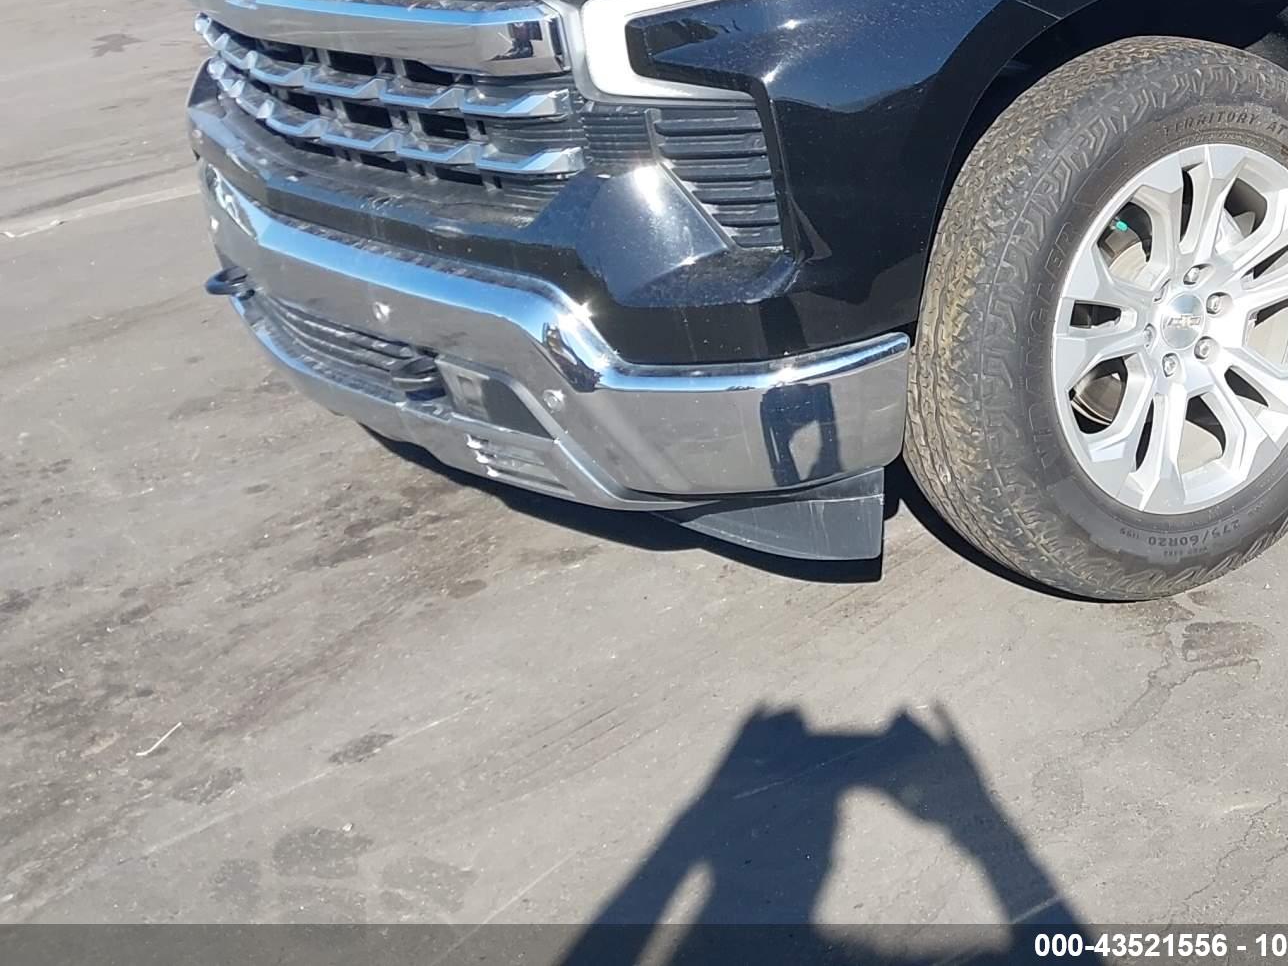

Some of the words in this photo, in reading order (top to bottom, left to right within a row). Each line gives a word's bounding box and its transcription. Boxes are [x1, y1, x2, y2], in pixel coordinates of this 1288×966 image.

[1162, 111, 1260, 136] TERRITORY
[1265, 121, 1288, 136] AT
[1147, 518, 1240, 547] 275/60R20
